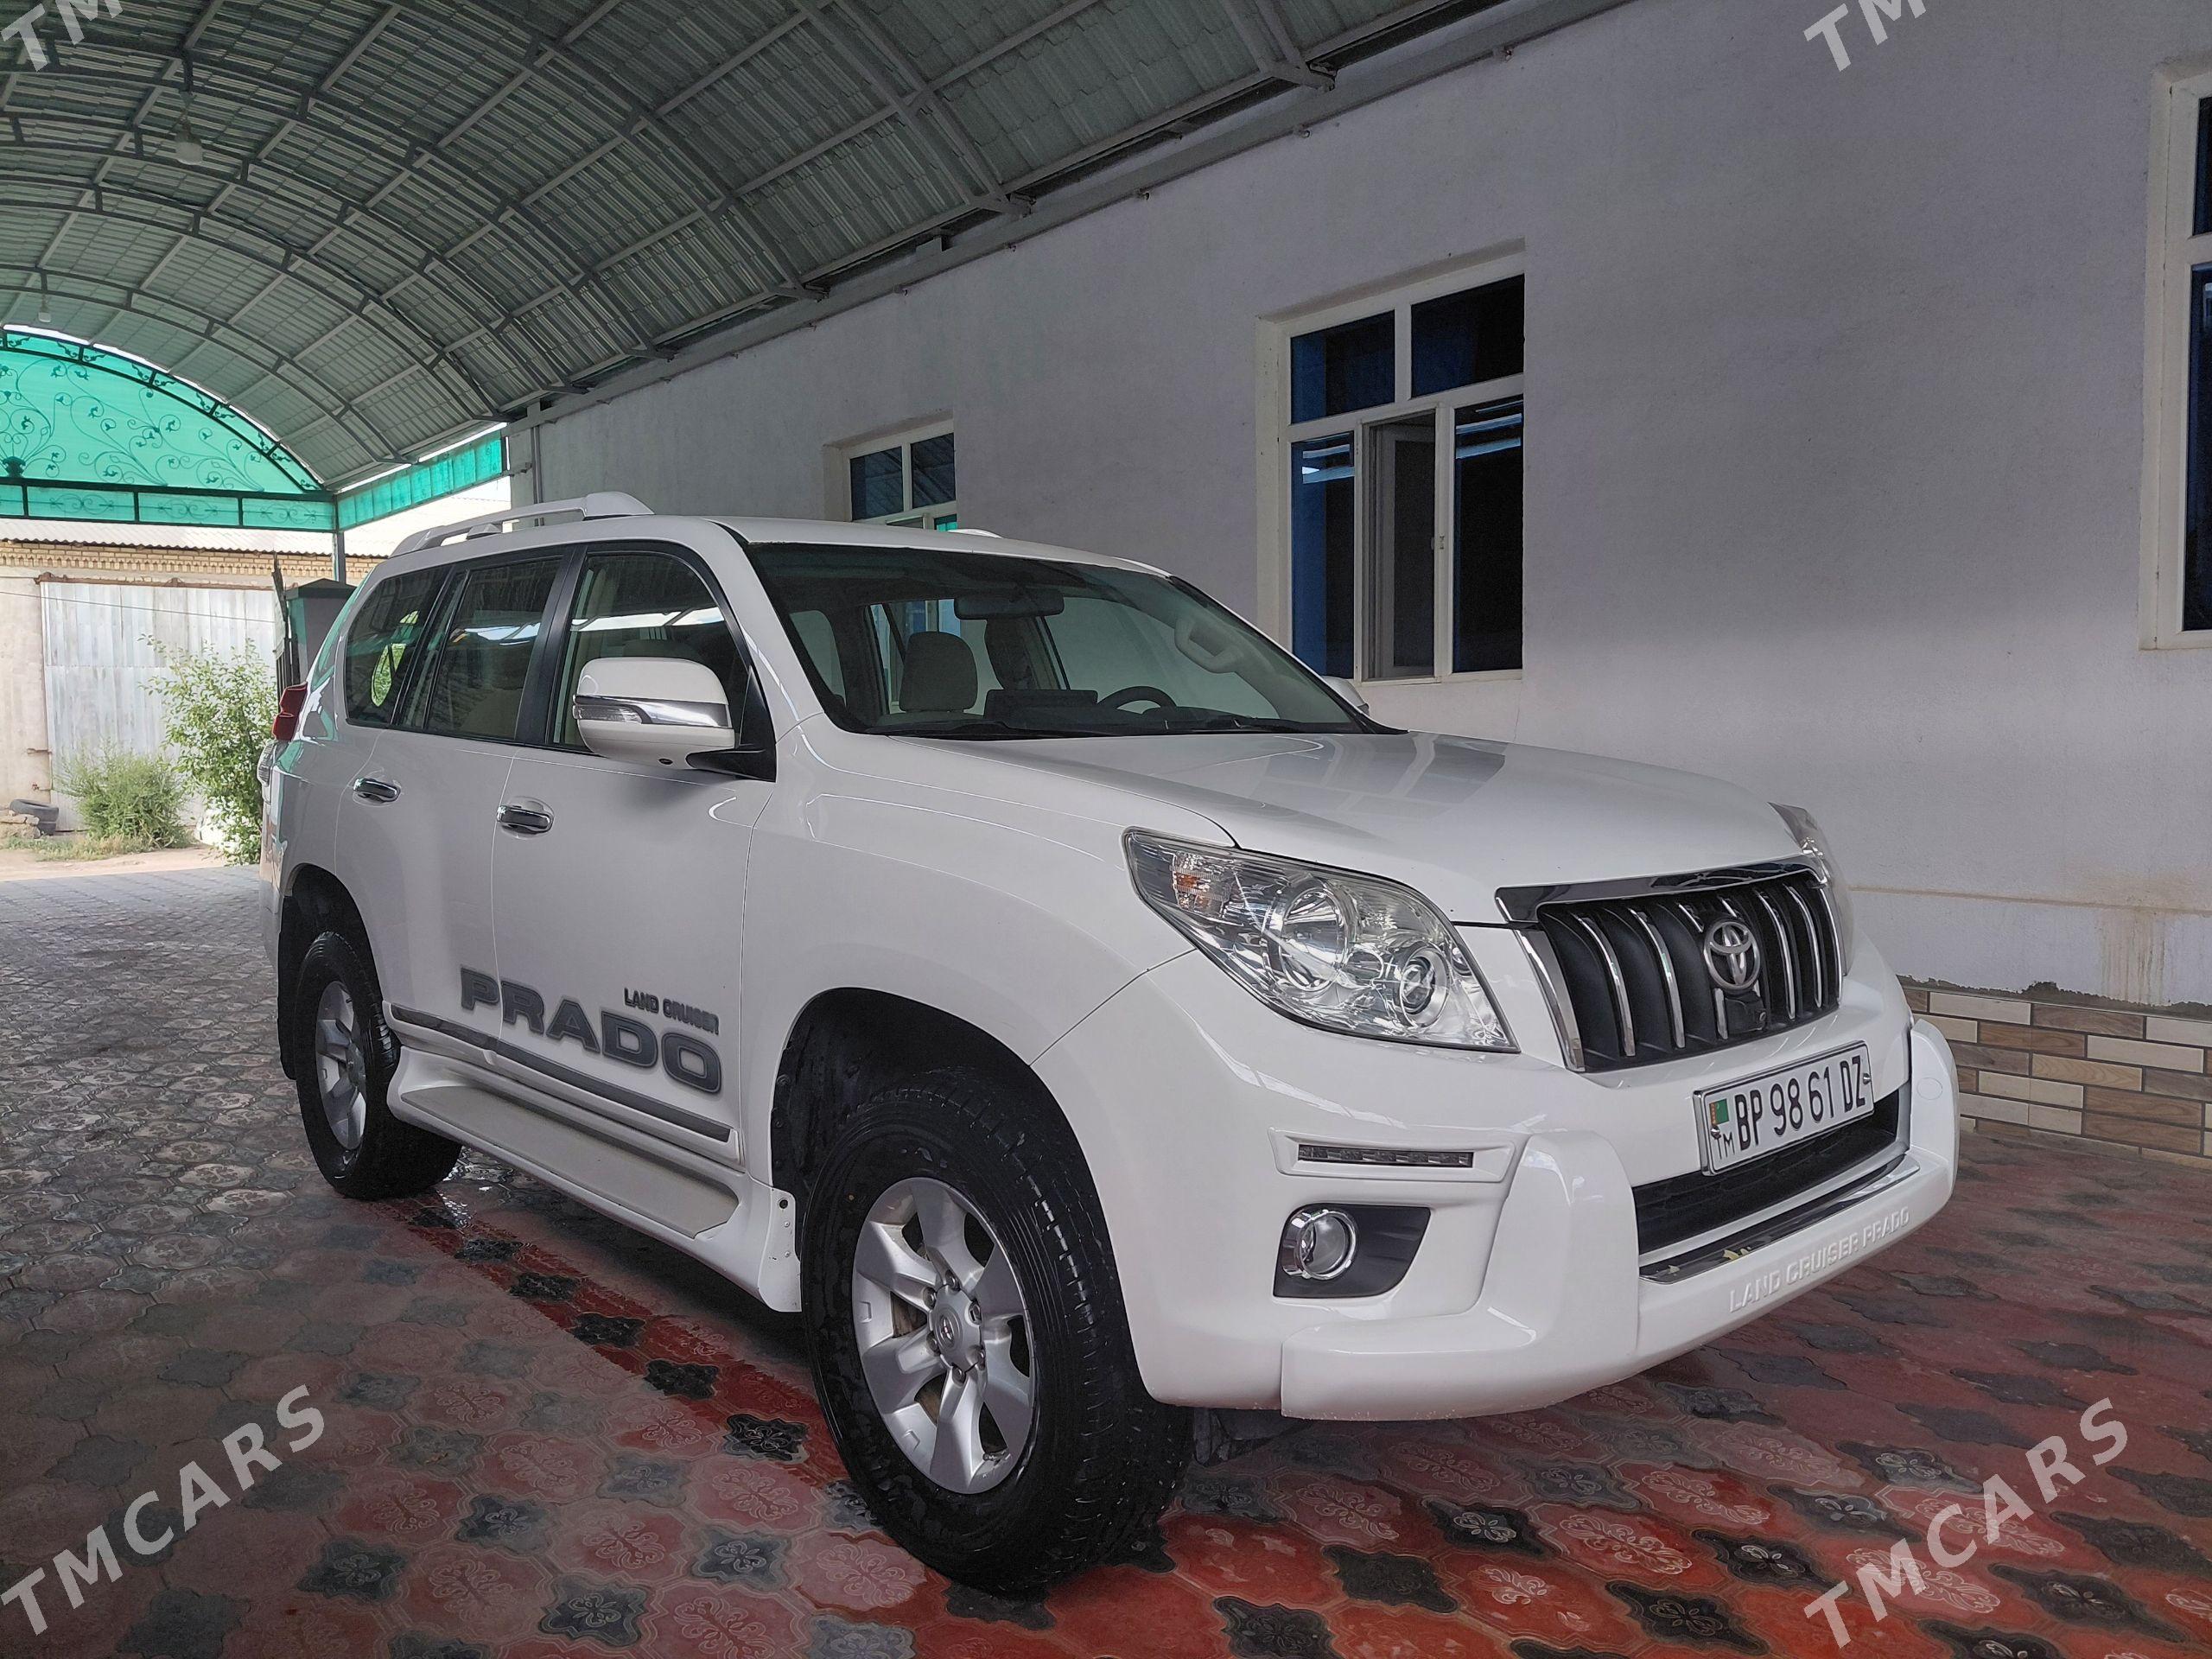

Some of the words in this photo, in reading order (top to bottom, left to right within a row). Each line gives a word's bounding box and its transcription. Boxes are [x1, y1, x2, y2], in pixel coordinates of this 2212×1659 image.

[460, 966, 722, 1094] PRADO
[624, 987, 659, 1014] LAND
[663, 998, 720, 1036] CRUISER
[1734, 1089, 1764, 1151] BP
[1770, 1077, 1803, 1137] 98
[1808, 1066, 1834, 1123] 61
[1840, 1055, 1866, 1114] DZ
[1729, 1270, 1781, 1313] LAND
[1786, 1231, 1859, 1285] CRUISER
[1862, 1205, 1910, 1248] PRADO
